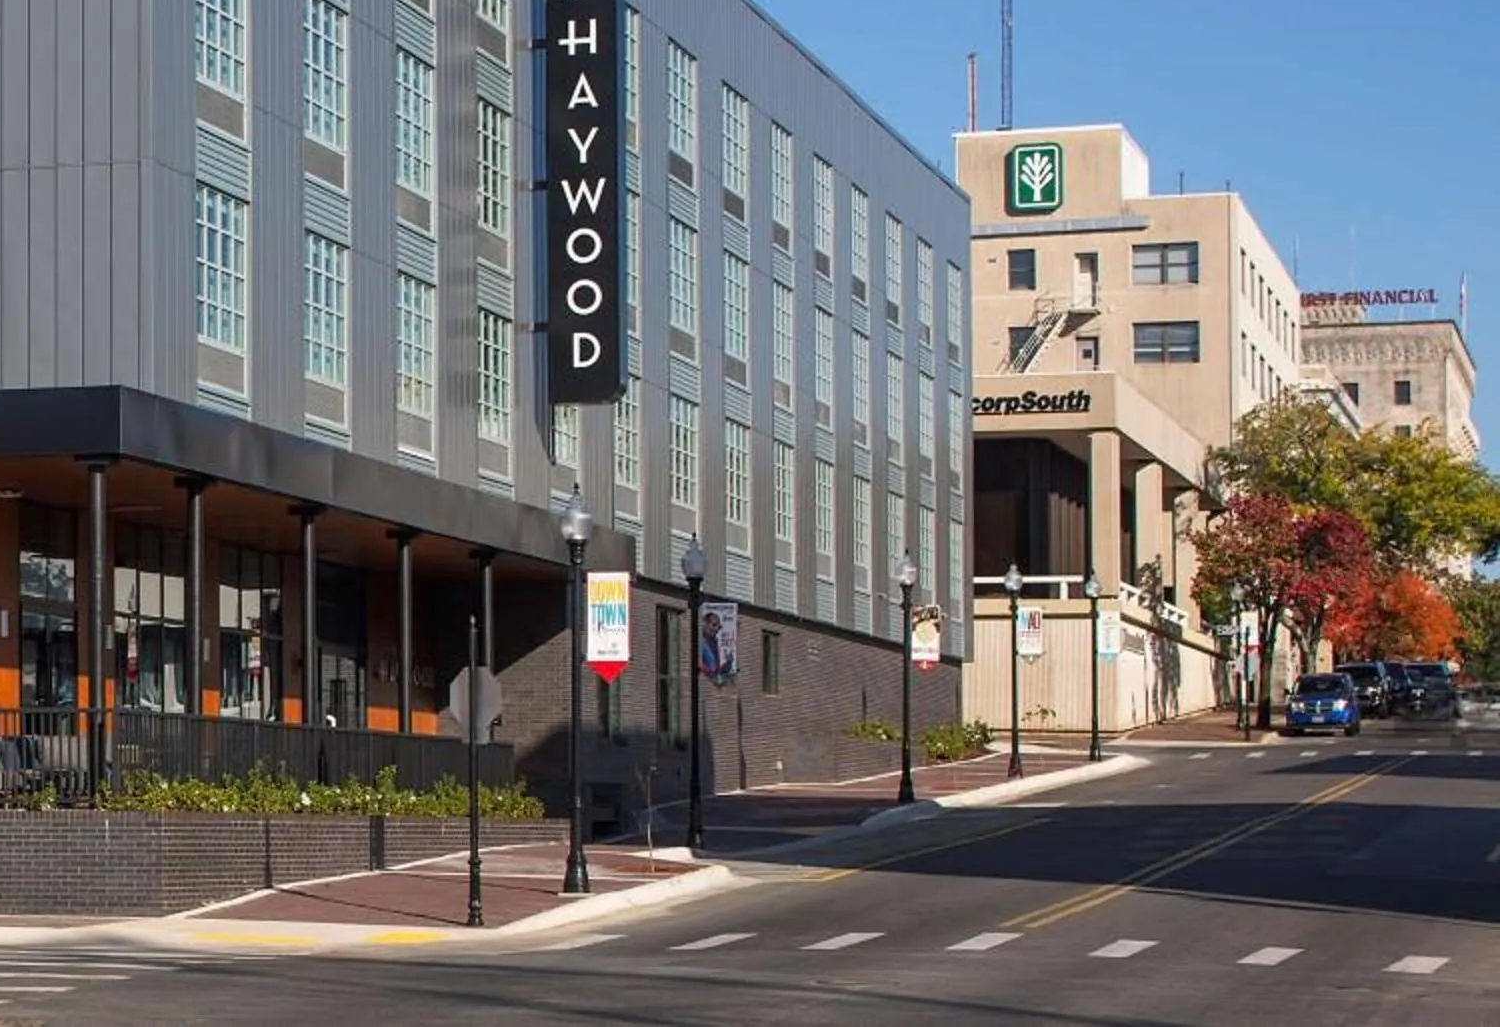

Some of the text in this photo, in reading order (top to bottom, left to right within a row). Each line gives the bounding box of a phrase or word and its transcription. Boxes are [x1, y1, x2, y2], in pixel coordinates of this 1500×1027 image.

[558, 18, 606, 369] HAYWOOD
[1340, 288, 1438, 306] FINANCIAL
[591, 604, 627, 626] TOWN
